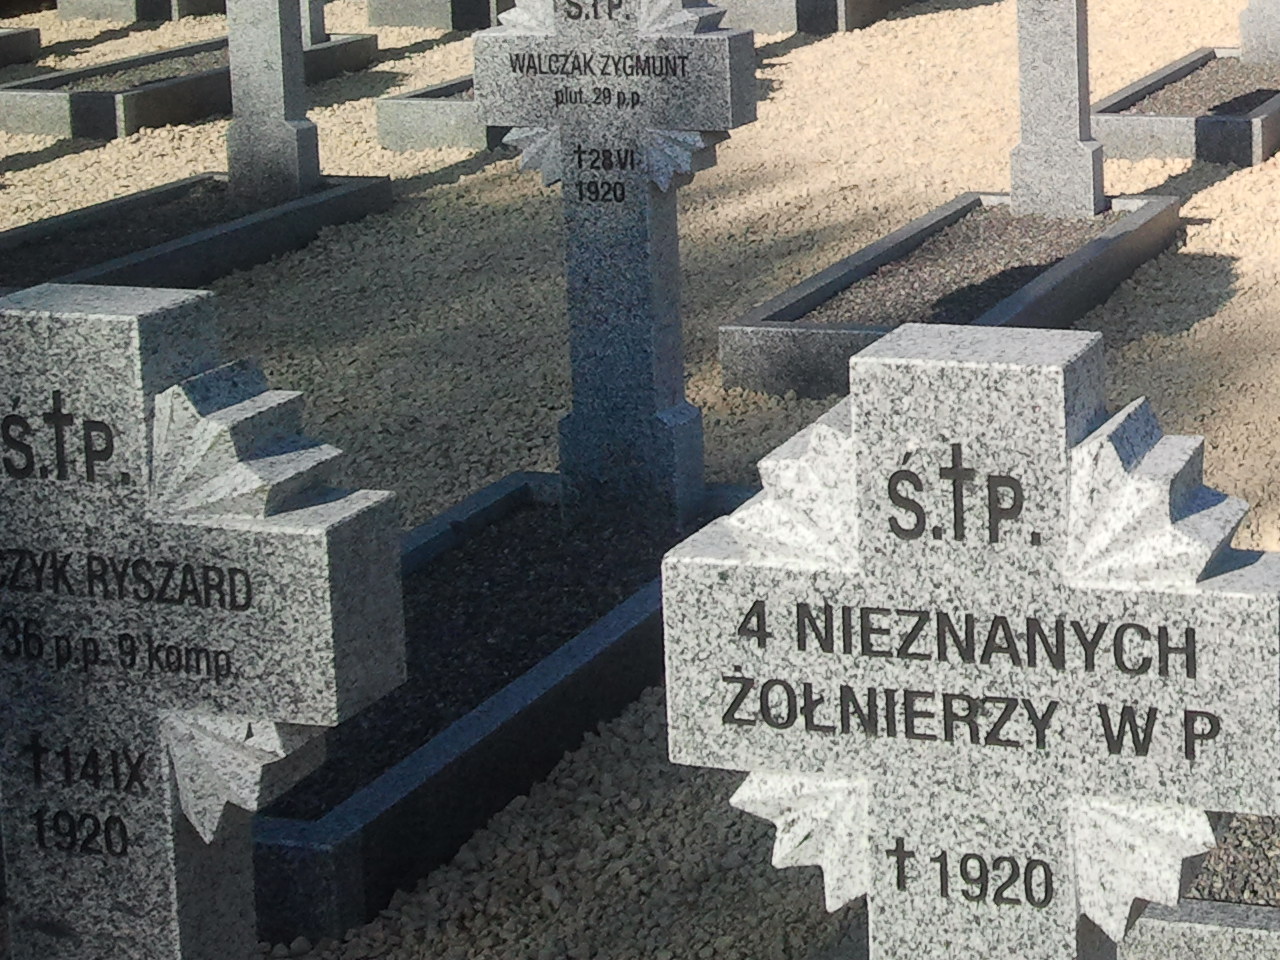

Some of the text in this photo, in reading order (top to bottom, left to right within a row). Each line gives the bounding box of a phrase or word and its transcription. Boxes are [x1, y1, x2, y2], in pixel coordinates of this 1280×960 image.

[509, 53, 688, 77] WALCZAK ZYGMUNT
[593, 87, 612, 105] 29
[589, 149, 635, 170] 28 VI
[577, 182, 626, 203] 1920
[86, 554, 252, 612] RYSZARD
[118, 633, 137, 668] 9
[149, 640, 239, 686] komp.
[737, 599, 1198, 679] 4 NIEZNANYCH
[720, 665, 1223, 761] ŻOŁNIERZY W P
[58, 745, 147, 792] 14 IX
[33, 808, 128, 857] 1920
[929, 848, 1055, 909] 1920
